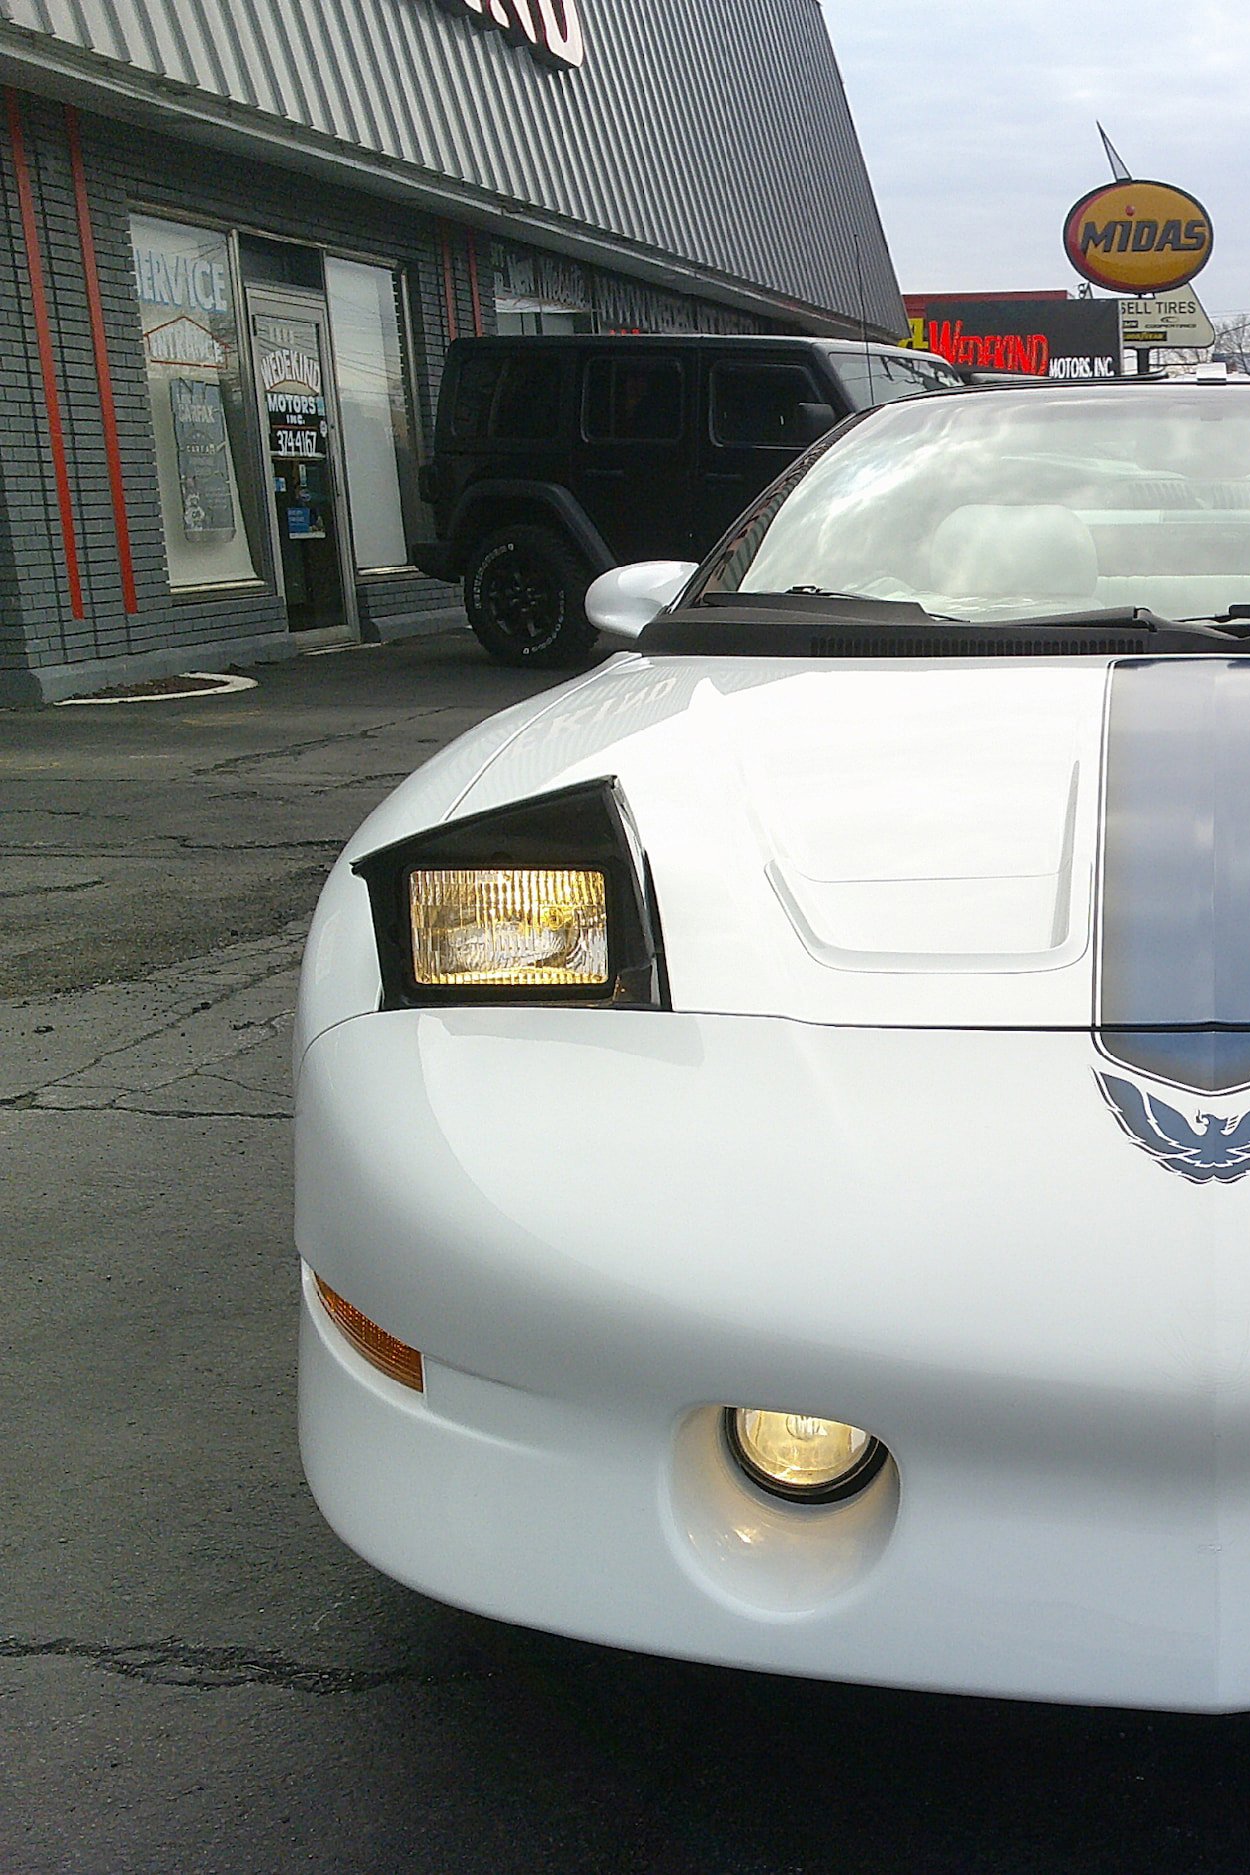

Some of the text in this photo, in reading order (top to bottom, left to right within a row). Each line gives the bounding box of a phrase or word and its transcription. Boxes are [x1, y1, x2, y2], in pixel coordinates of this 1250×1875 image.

[1080, 206, 1208, 258] MIDAS
[133, 249, 228, 316] ERVICE
[1156, 301, 1197, 314] TIRES
[260, 349, 321, 395] WEDEKIND
[266, 393, 316, 415] MOTORS
